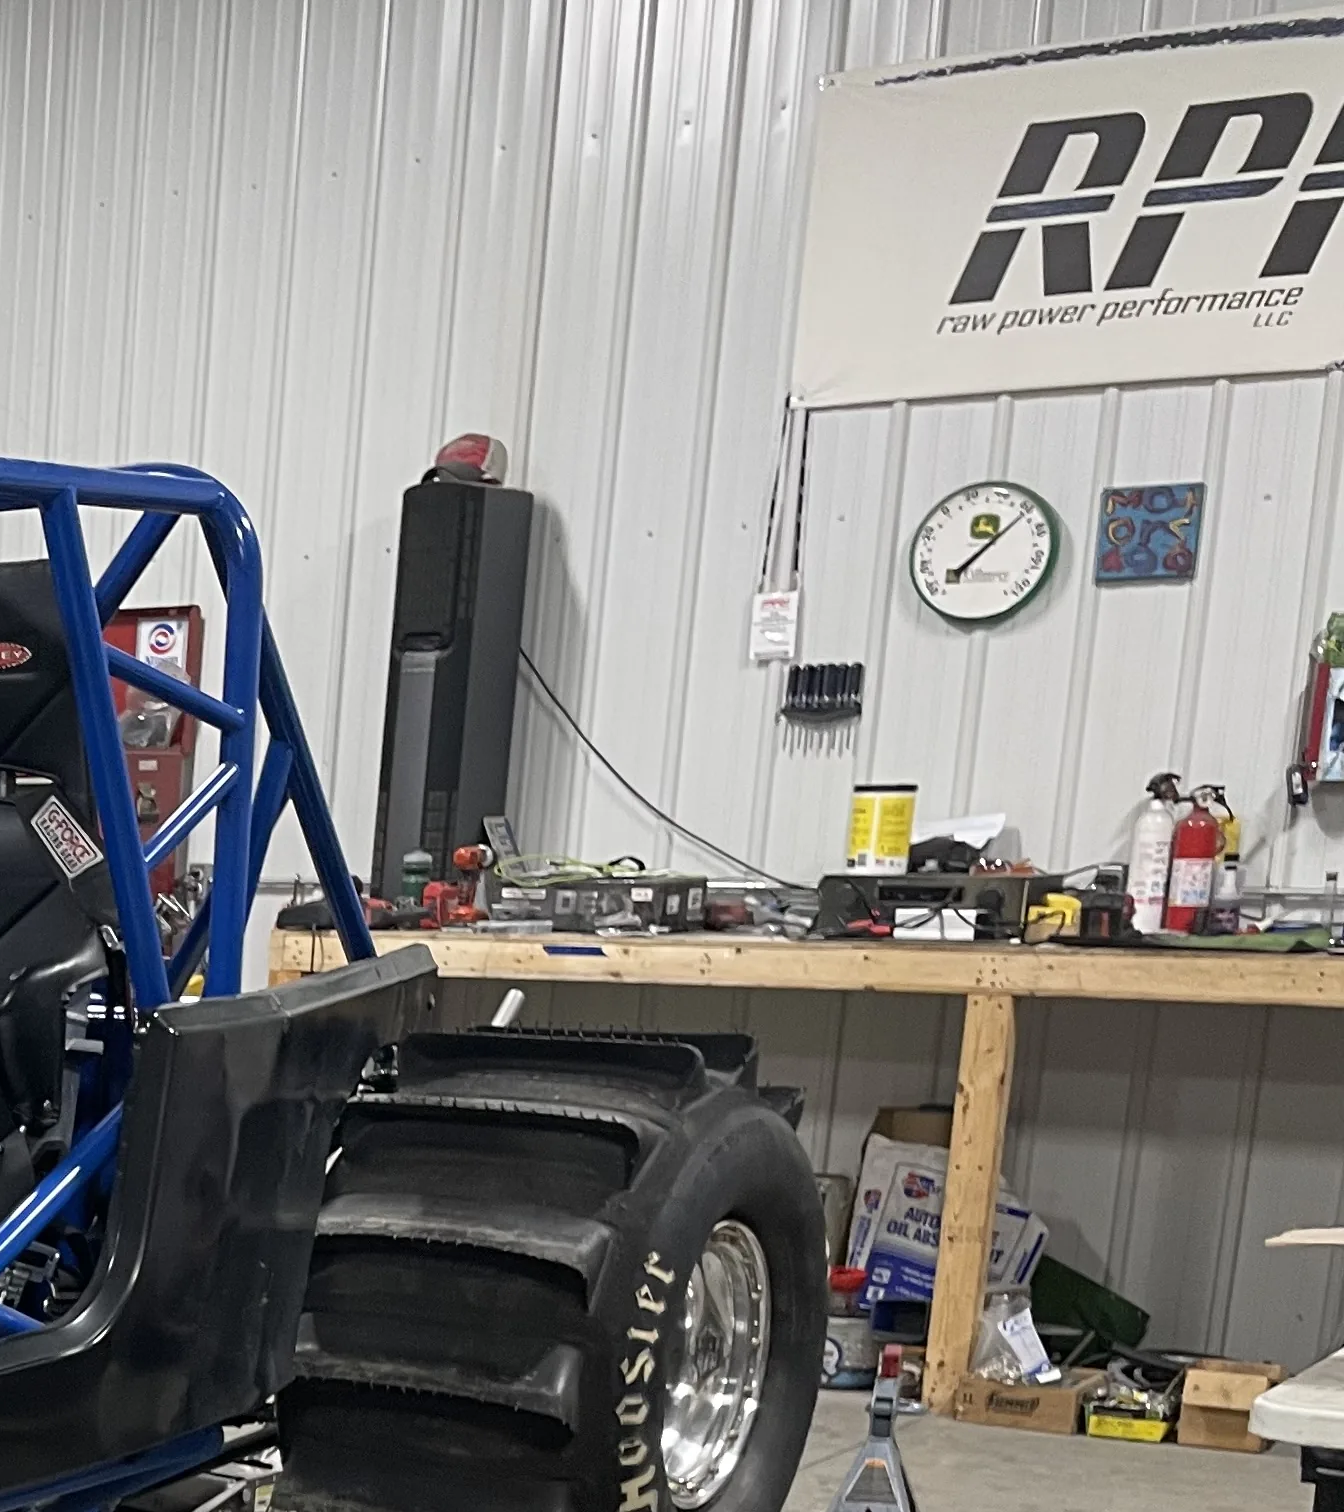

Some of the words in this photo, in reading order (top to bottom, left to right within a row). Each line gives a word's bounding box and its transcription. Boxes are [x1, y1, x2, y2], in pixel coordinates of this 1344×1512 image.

[937, 311, 996, 334] raw
[997, 303, 1096, 335] power
[1097, 287, 1304, 327] performance
[1253, 311, 1293, 328] LLC
[886, 1218, 909, 1237] OIL
